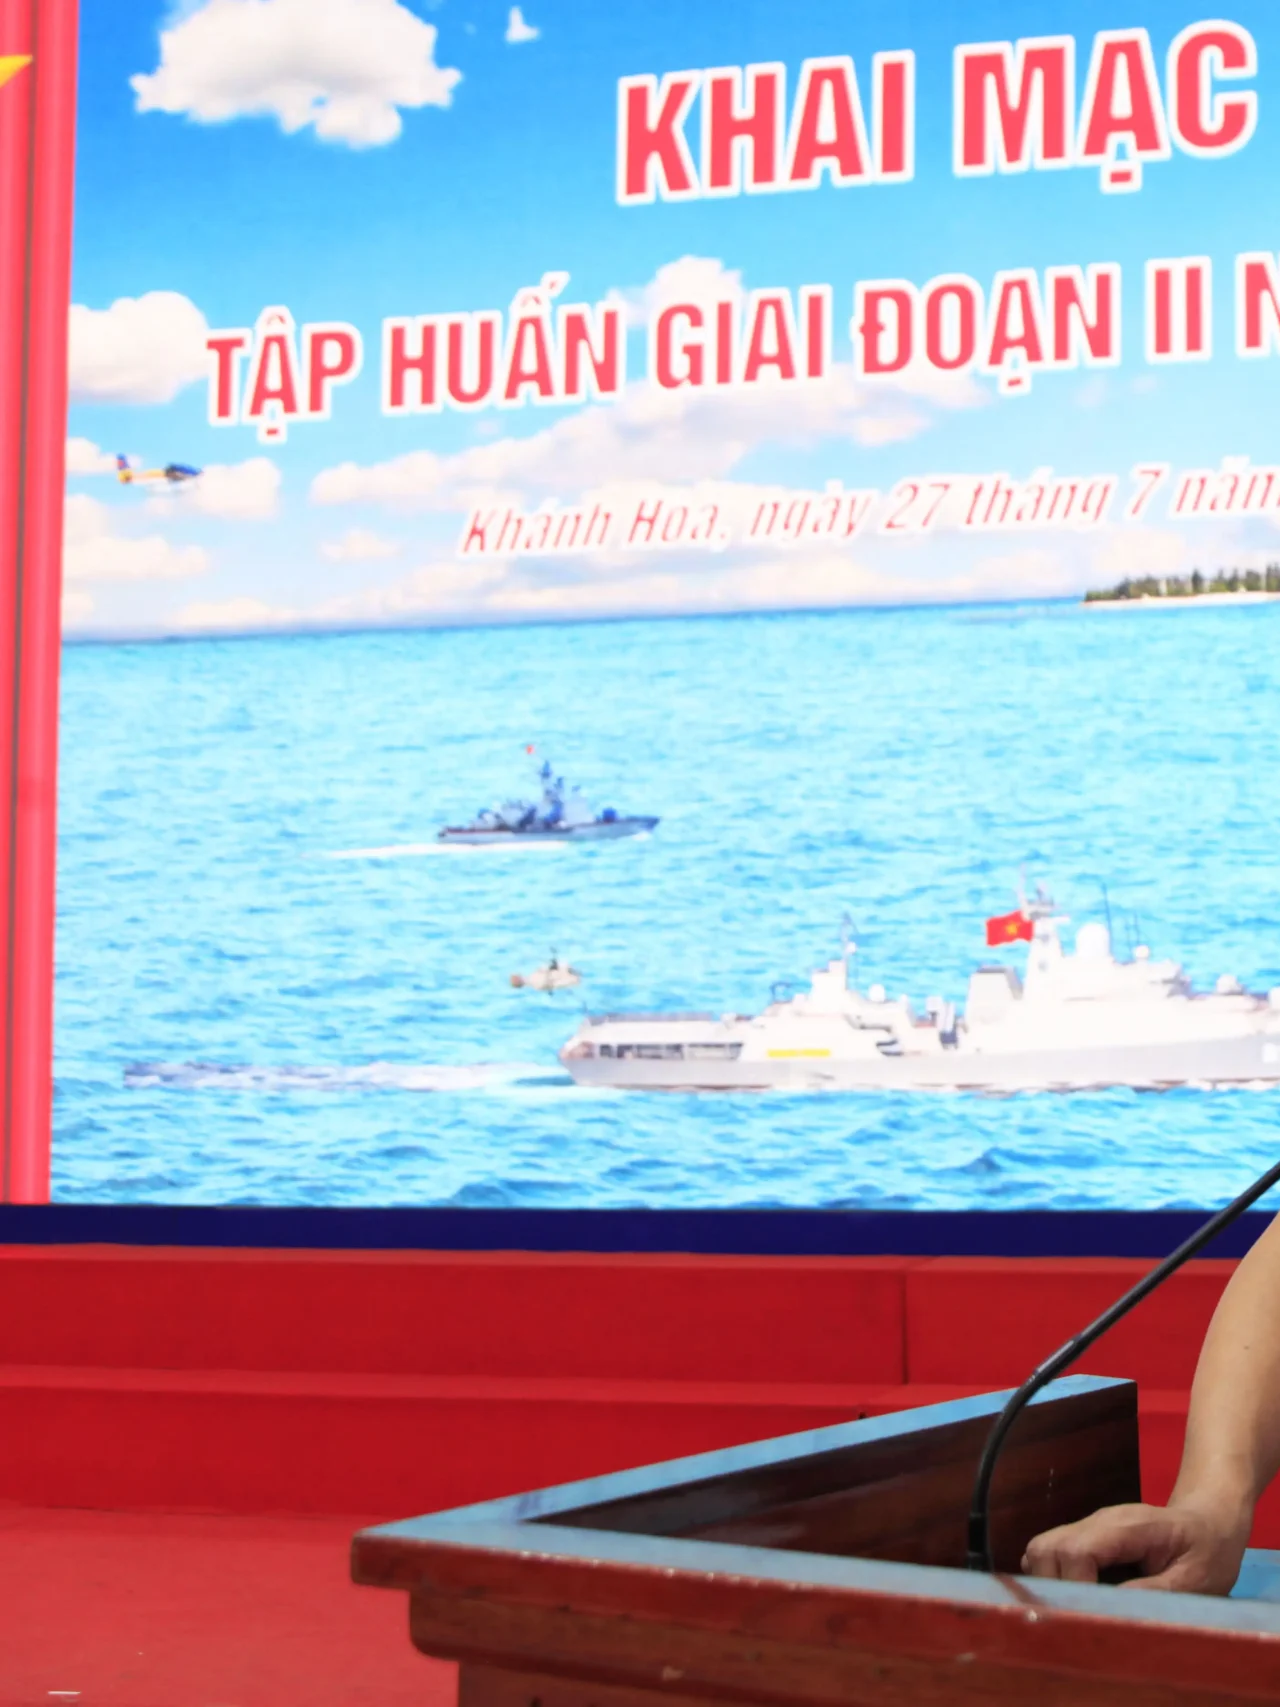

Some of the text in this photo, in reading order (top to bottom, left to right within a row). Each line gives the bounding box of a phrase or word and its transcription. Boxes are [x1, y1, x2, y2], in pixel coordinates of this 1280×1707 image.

[621, 25, 1252, 200] KHAI MẠC
[203, 311, 358, 439] TẬP
[386, 278, 621, 410] HUẤN
[653, 291, 827, 391] GIAI
[856, 270, 1115, 390] ĐOẠN
[1151, 262, 1206, 357] II
[460, 499, 615, 555] Khánh
[882, 480, 953, 532] 27
[962, 470, 1113, 528] tháng
[1130, 467, 1165, 517] 7
